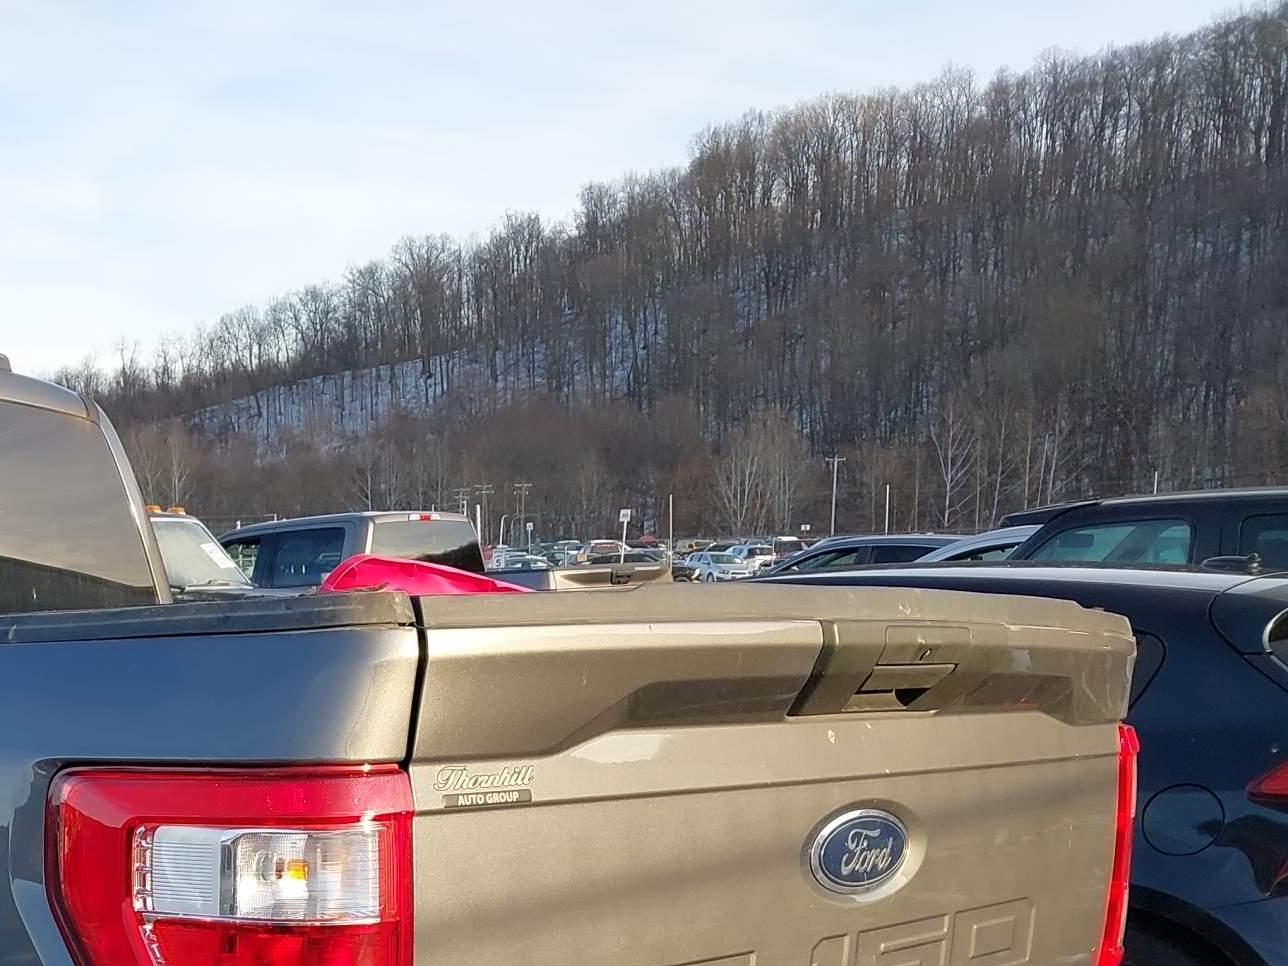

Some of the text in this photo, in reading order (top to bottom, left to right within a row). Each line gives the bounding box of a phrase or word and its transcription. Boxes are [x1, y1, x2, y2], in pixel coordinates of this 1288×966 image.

[433, 765, 535, 791] Thornhill
[458, 791, 519, 806] AUTO GROUP
[841, 828, 894, 876] Ford
